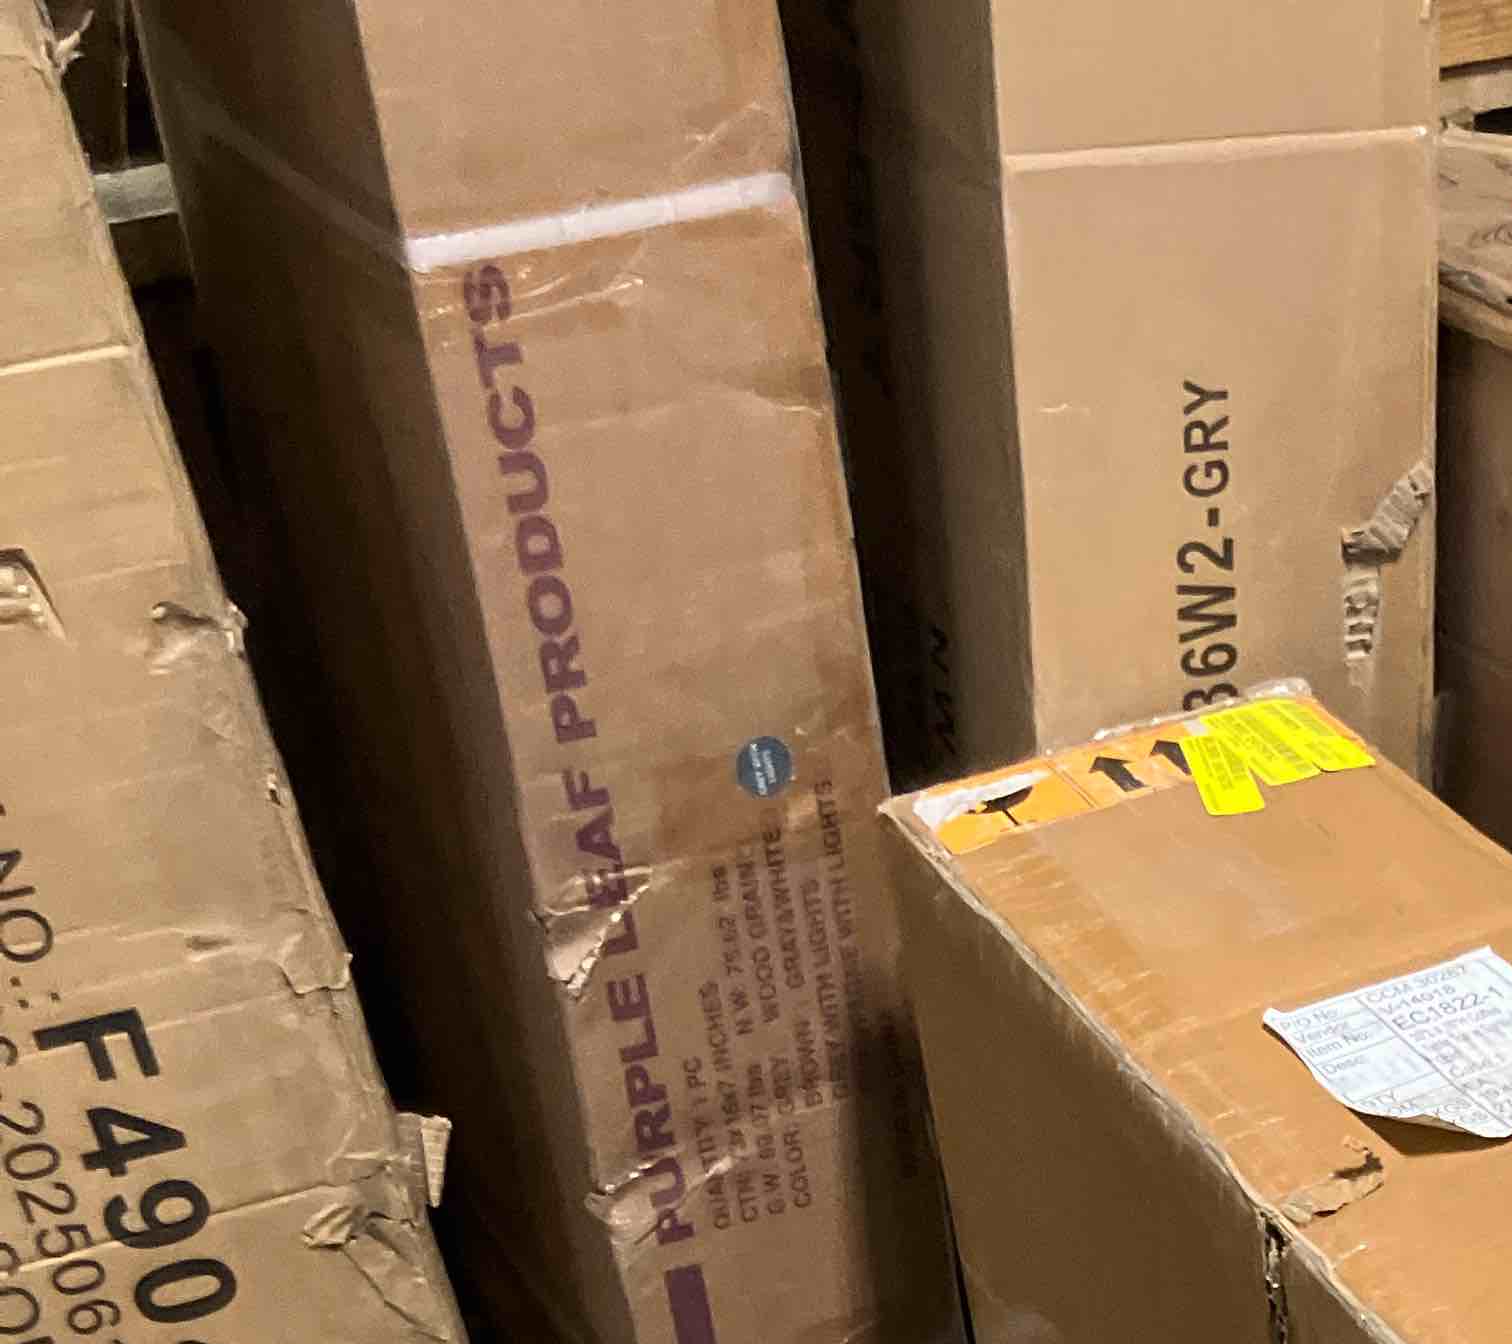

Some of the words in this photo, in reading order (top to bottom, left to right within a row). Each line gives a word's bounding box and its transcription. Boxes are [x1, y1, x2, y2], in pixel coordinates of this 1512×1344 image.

[463, 264, 597, 745] PRODUCTS
[562, 768, 638, 955] LEAF
[607, 973, 696, 1246] PURPLE
